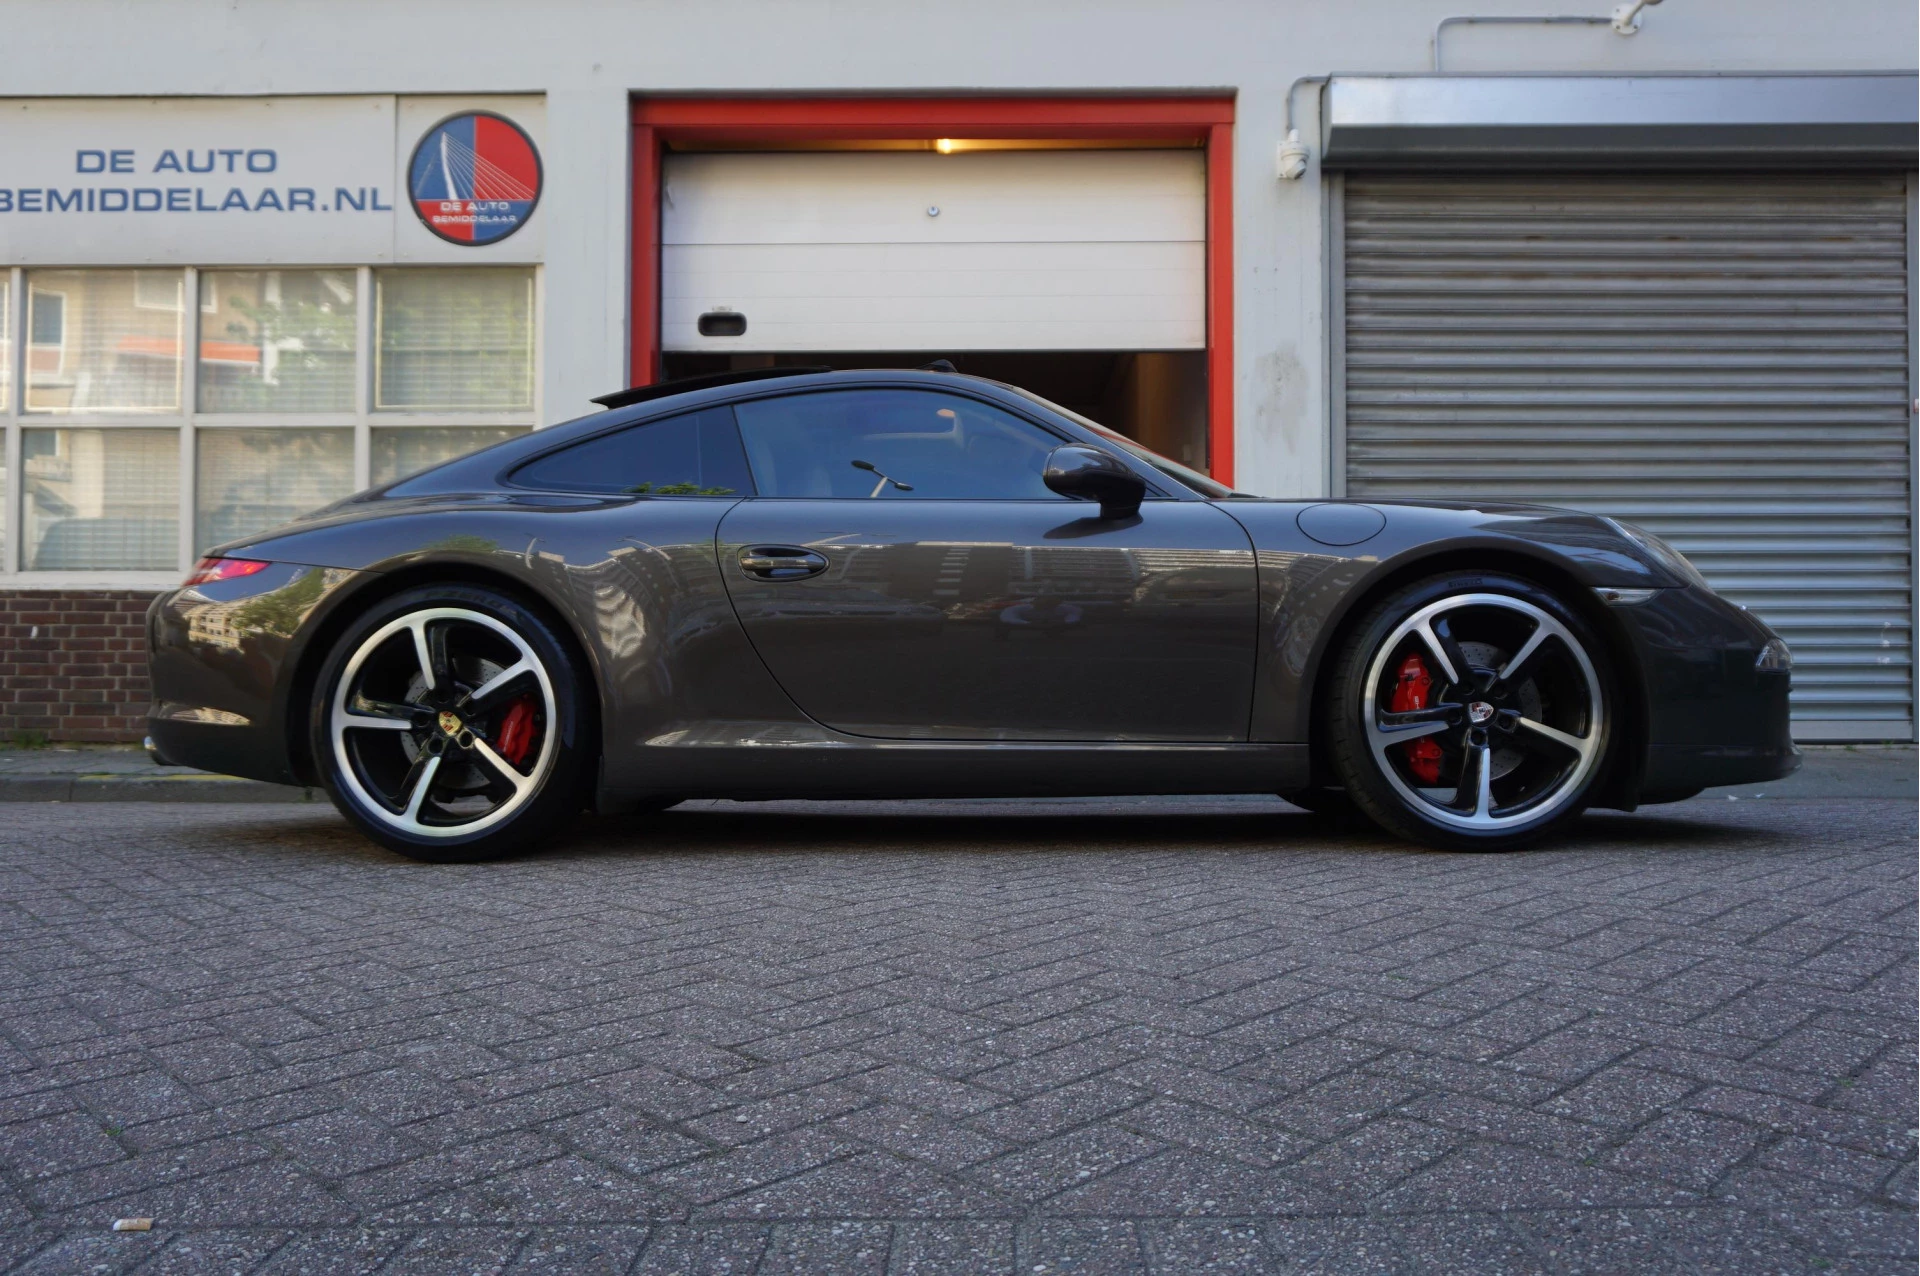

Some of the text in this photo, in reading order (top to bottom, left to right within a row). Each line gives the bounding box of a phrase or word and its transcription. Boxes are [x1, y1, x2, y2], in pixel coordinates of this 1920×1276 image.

[76, 149, 277, 173] DE AUTO
[440, 201, 510, 211] DE AUTO
[432, 215, 517, 223] BEMIDDELAAR
